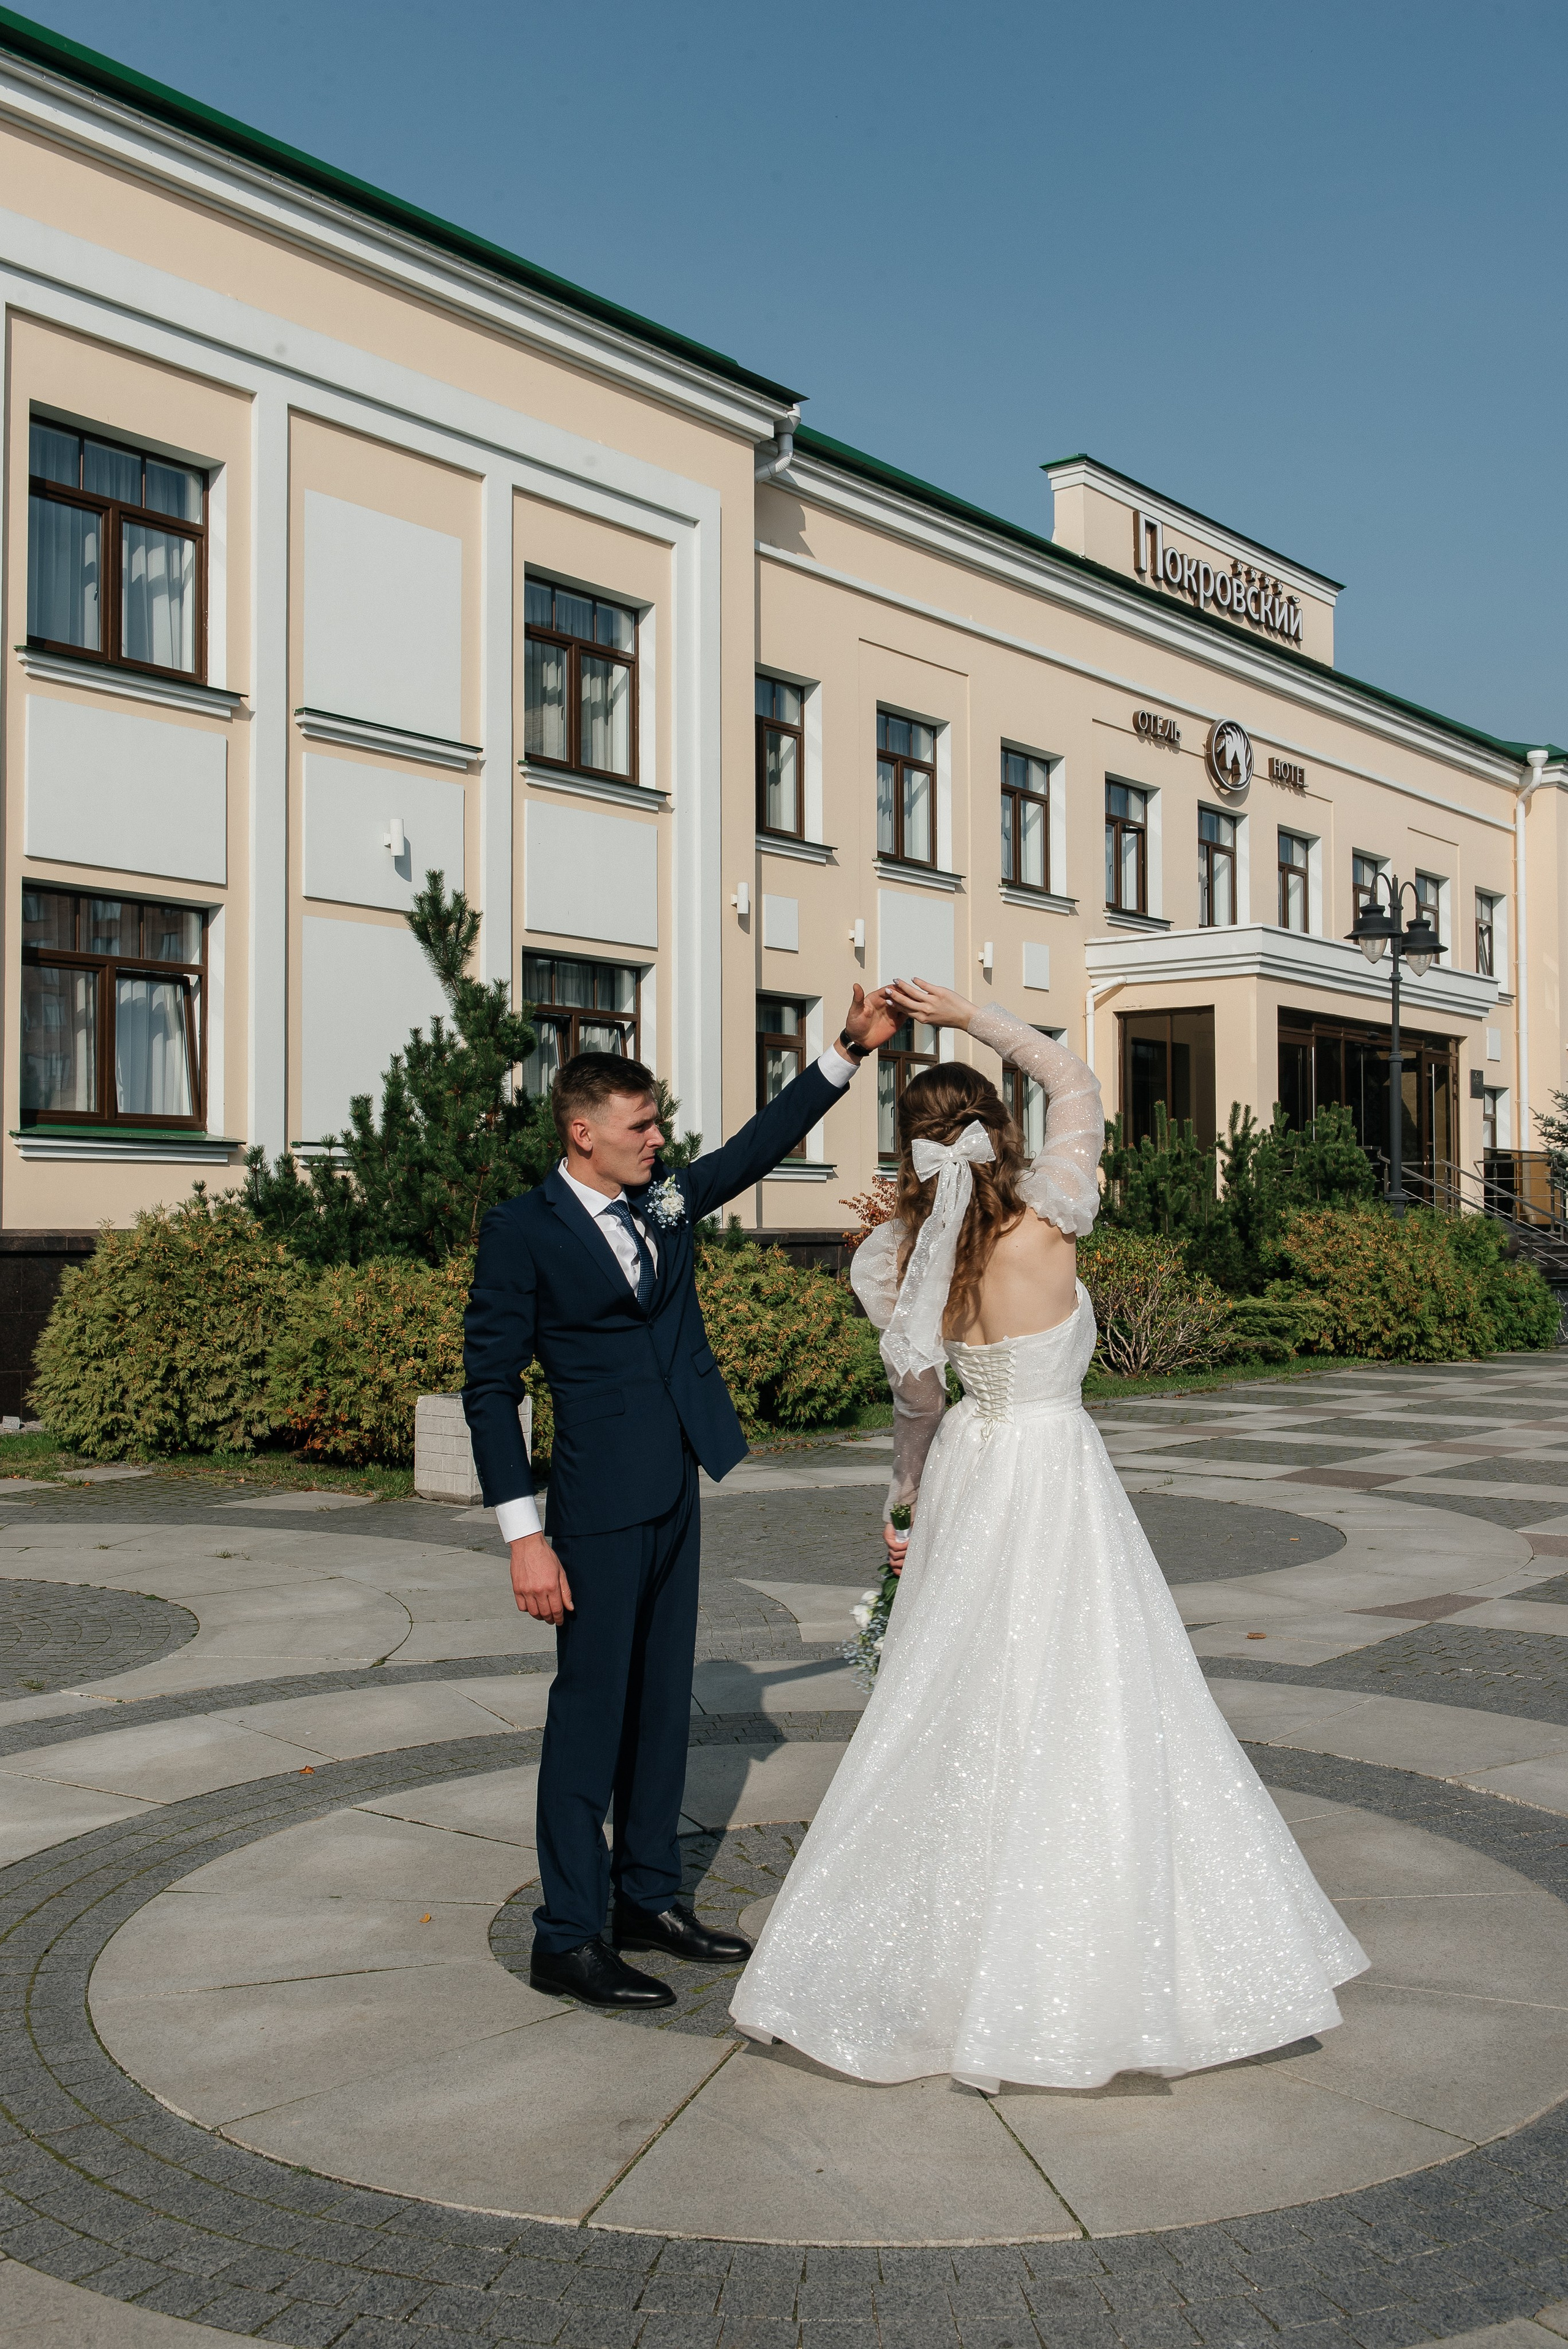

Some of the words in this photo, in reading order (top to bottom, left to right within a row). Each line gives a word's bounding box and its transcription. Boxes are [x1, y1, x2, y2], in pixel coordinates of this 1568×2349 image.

[1135, 510, 1303, 641] Покровский
[1136, 709, 1182, 741] ОТЕЛЬ
[1271, 757, 1309, 788] HOTEL
